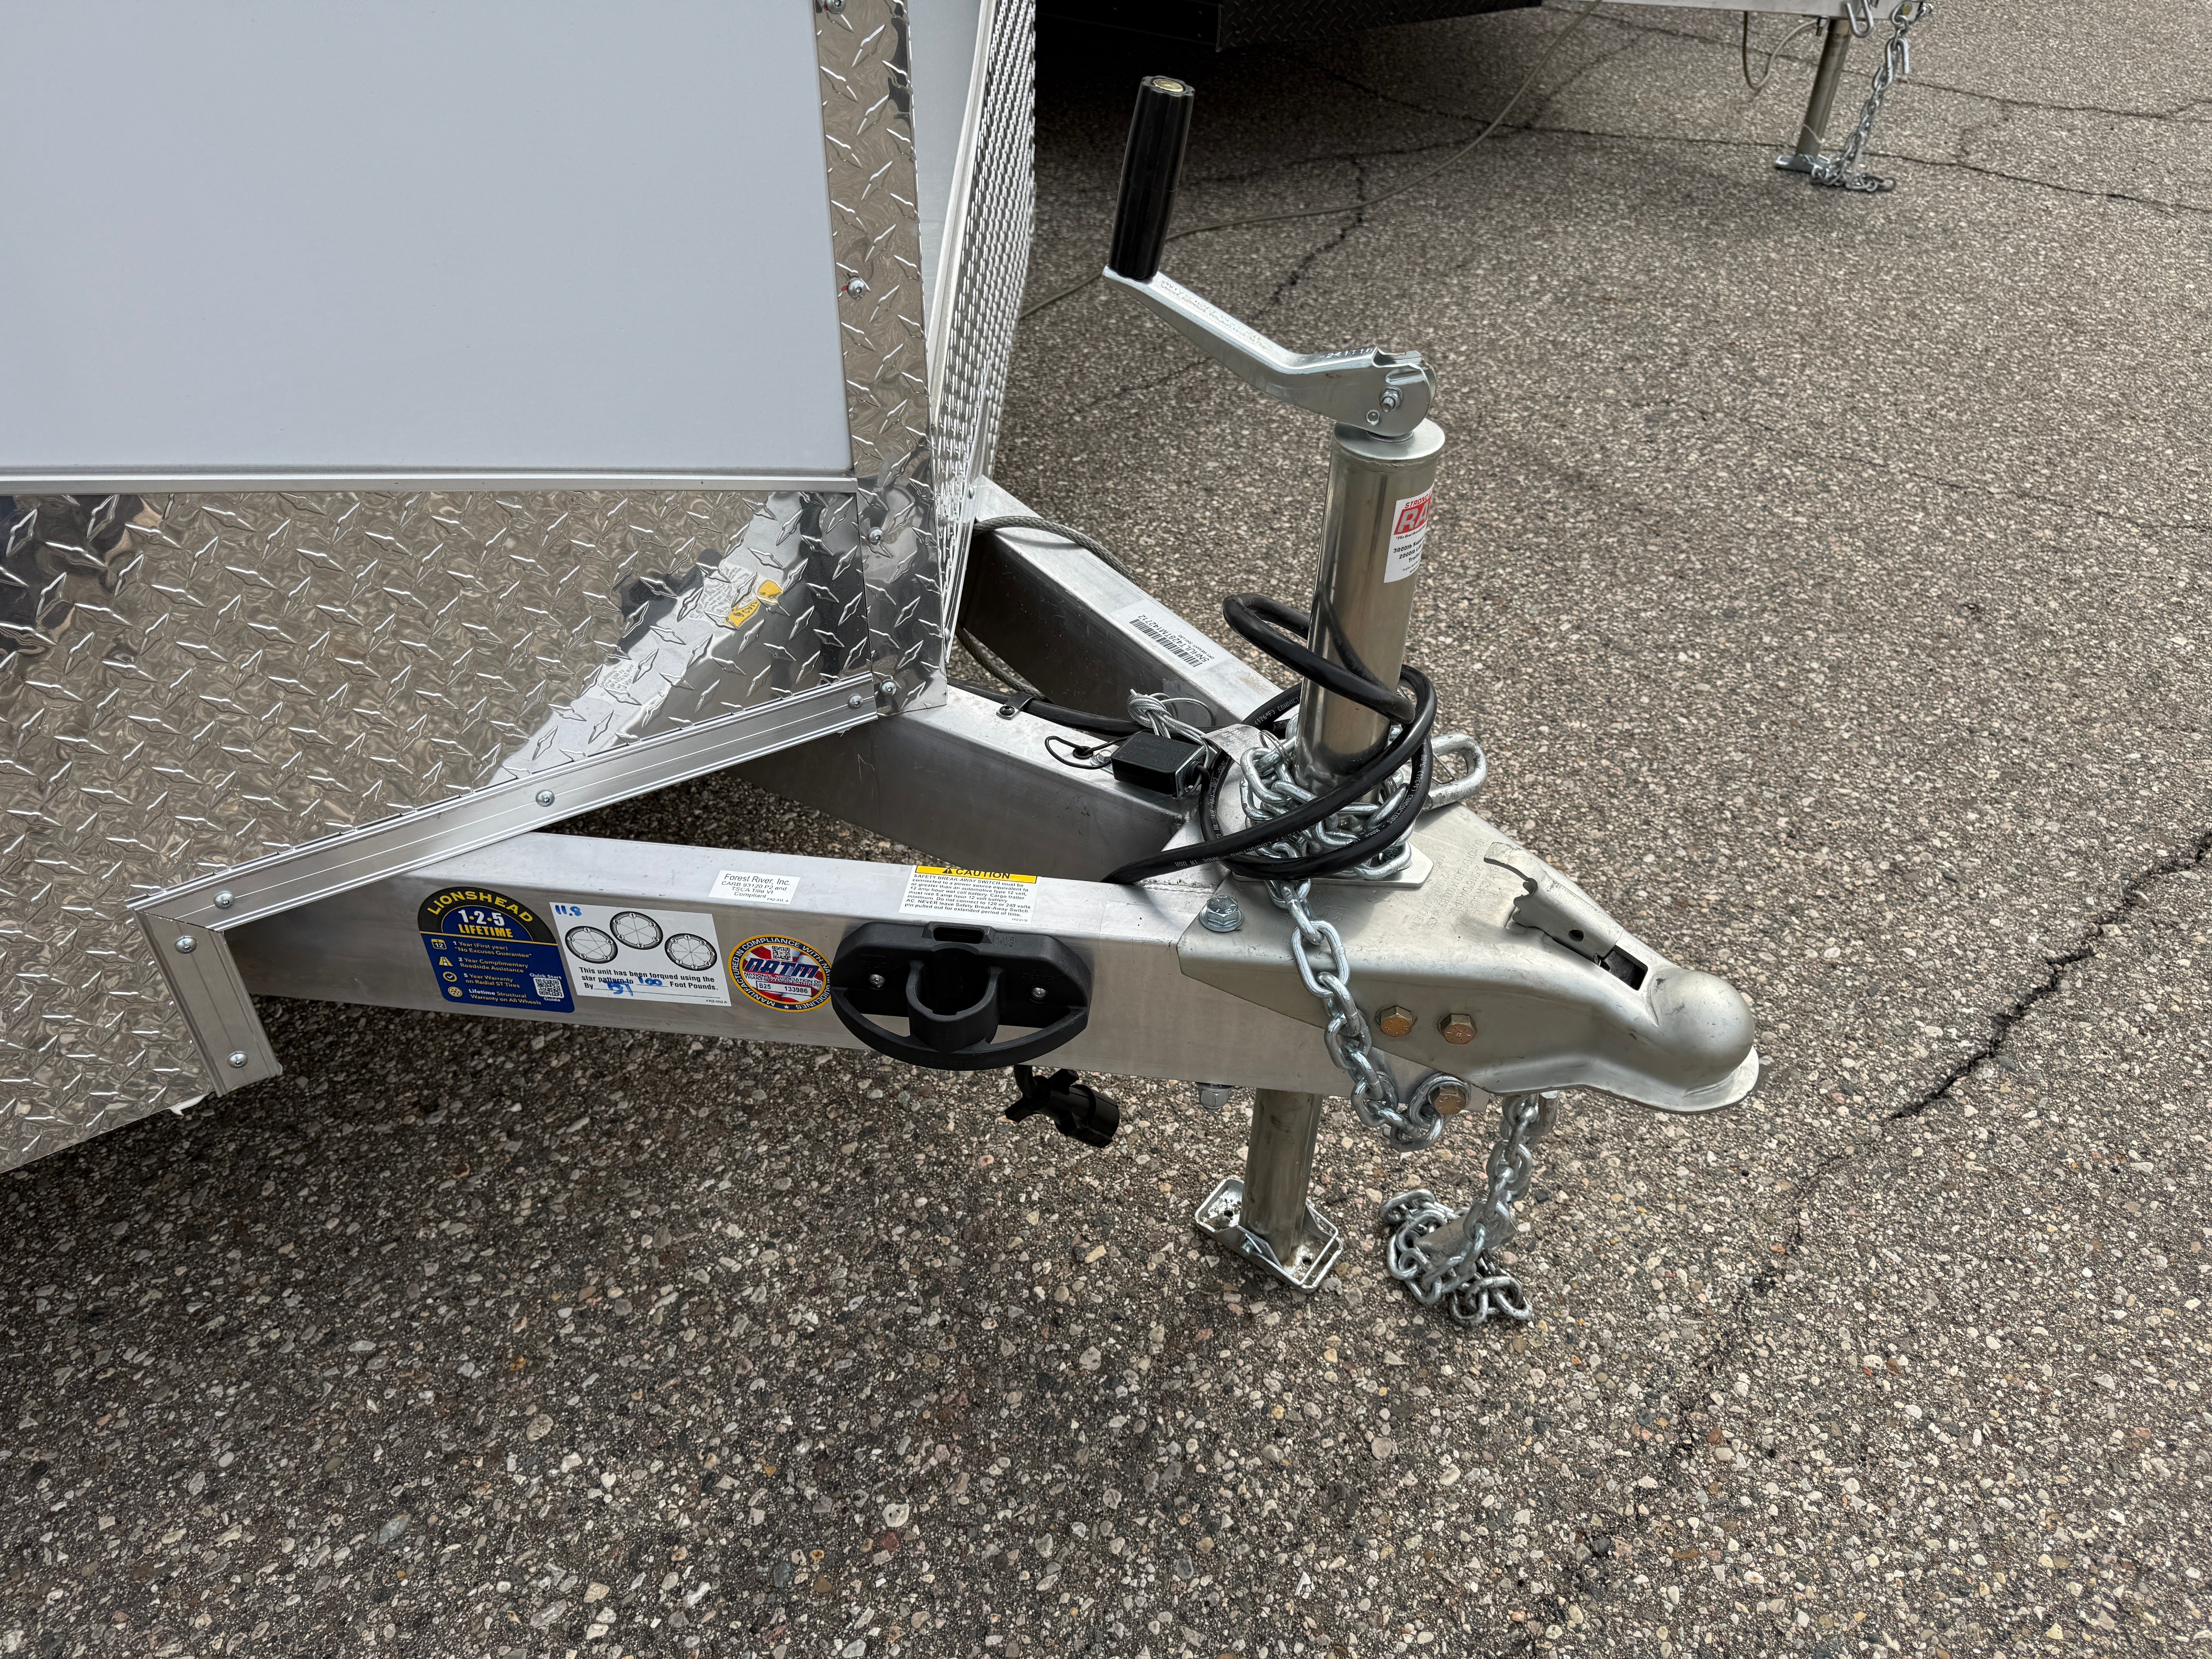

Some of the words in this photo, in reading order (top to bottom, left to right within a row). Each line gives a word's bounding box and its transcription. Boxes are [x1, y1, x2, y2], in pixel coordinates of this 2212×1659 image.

[1277, 696, 1300, 711] CONDUCT
[724, 873, 750, 882] Forest
[751, 876, 773, 885] River,
[956, 869, 1011, 879] CAUTION
[427, 891, 533, 922] LIONSHEAD
[458, 924, 514, 938] LIFETIME
[742, 938, 800, 950] COMPLIANCE
[737, 949, 744, 957] IN
[802, 945, 824, 962] WITH
[479, 959, 528, 969] Complimentary
[732, 957, 775, 1006] MANUFACTURED
